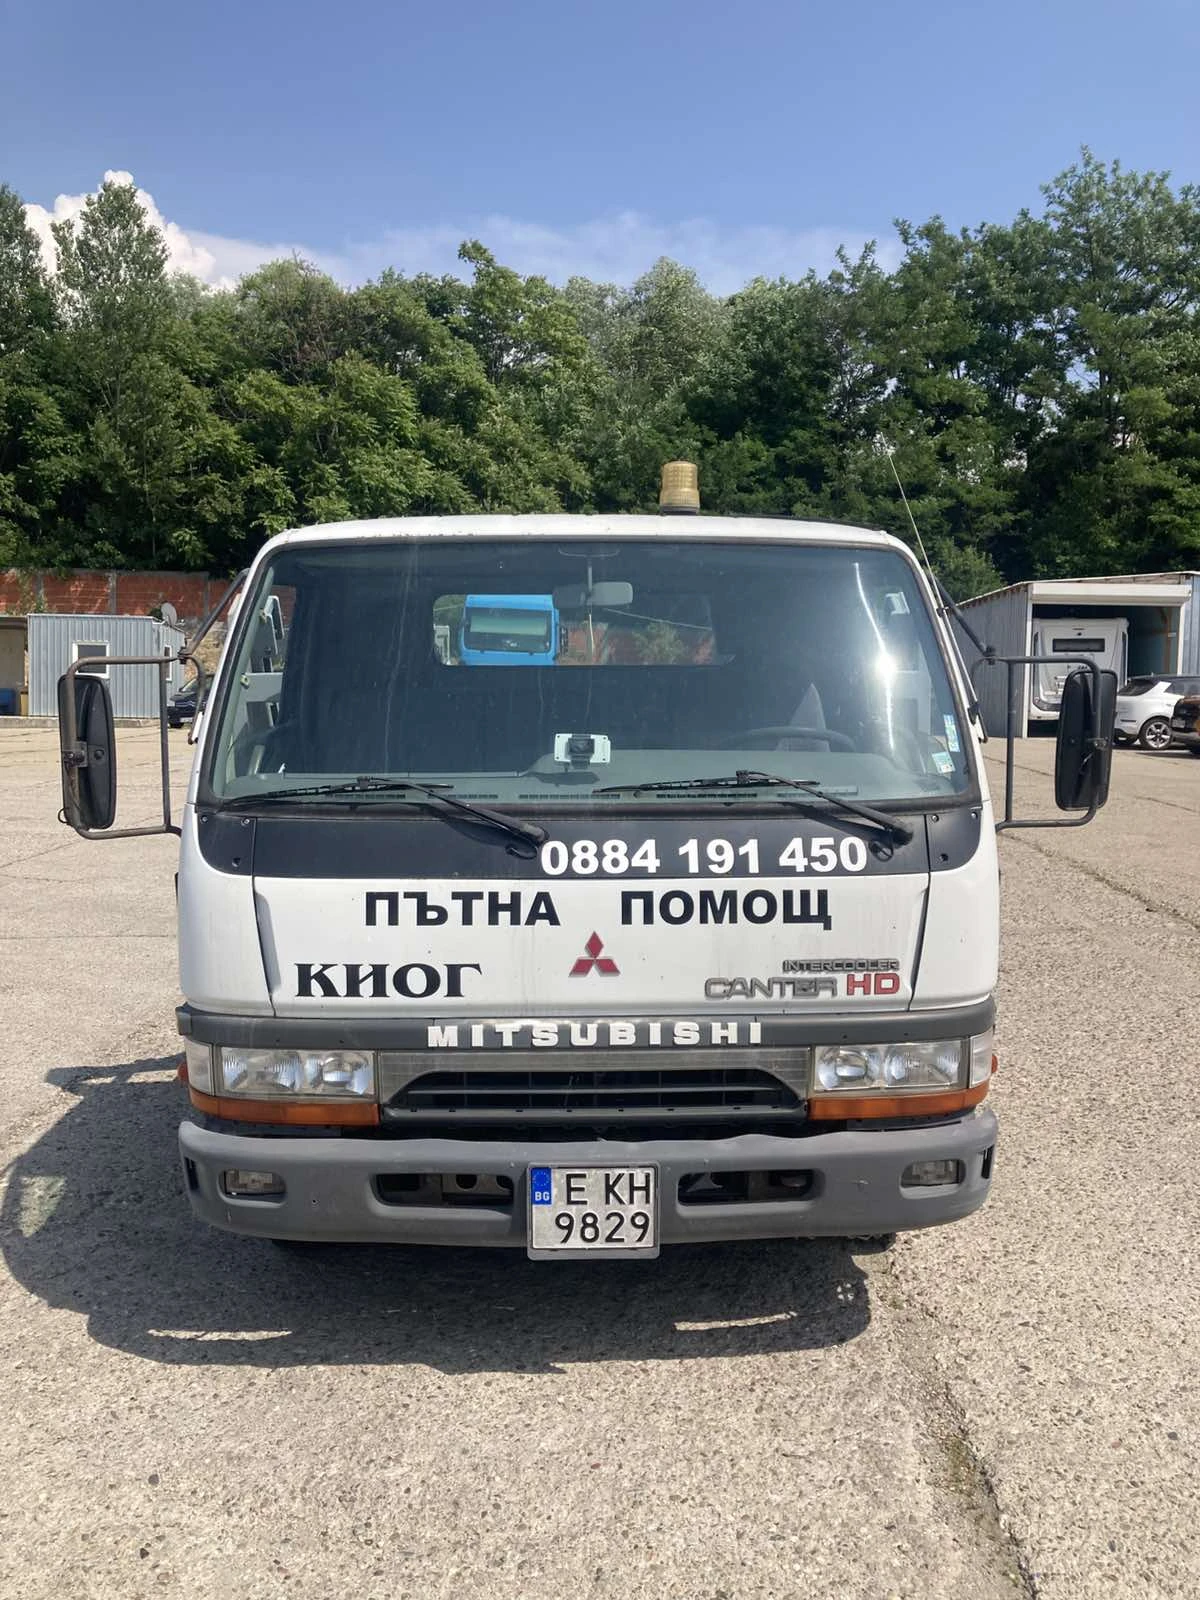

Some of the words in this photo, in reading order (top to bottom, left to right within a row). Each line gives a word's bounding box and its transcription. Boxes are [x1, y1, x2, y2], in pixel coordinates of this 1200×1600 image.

[540, 838, 661, 876] 0884
[678, 837, 761, 875] 191
[778, 836, 868, 874] 450
[364, 891, 561, 927] ПЪТНА
[620, 889, 832, 931] ПОМОЩ
[293, 962, 483, 999] КИОГ
[782, 958, 900, 973] INTERCOOLER
[704, 976, 838, 1001] CANTER
[846, 973, 901, 996] HD
[427, 1021, 763, 1048] MITSUBISHI
[534, 1192, 550, 1202] BG
[566, 1173, 588, 1205] E
[604, 1172, 651, 1205] KH
[554, 1211, 651, 1244] 9829
